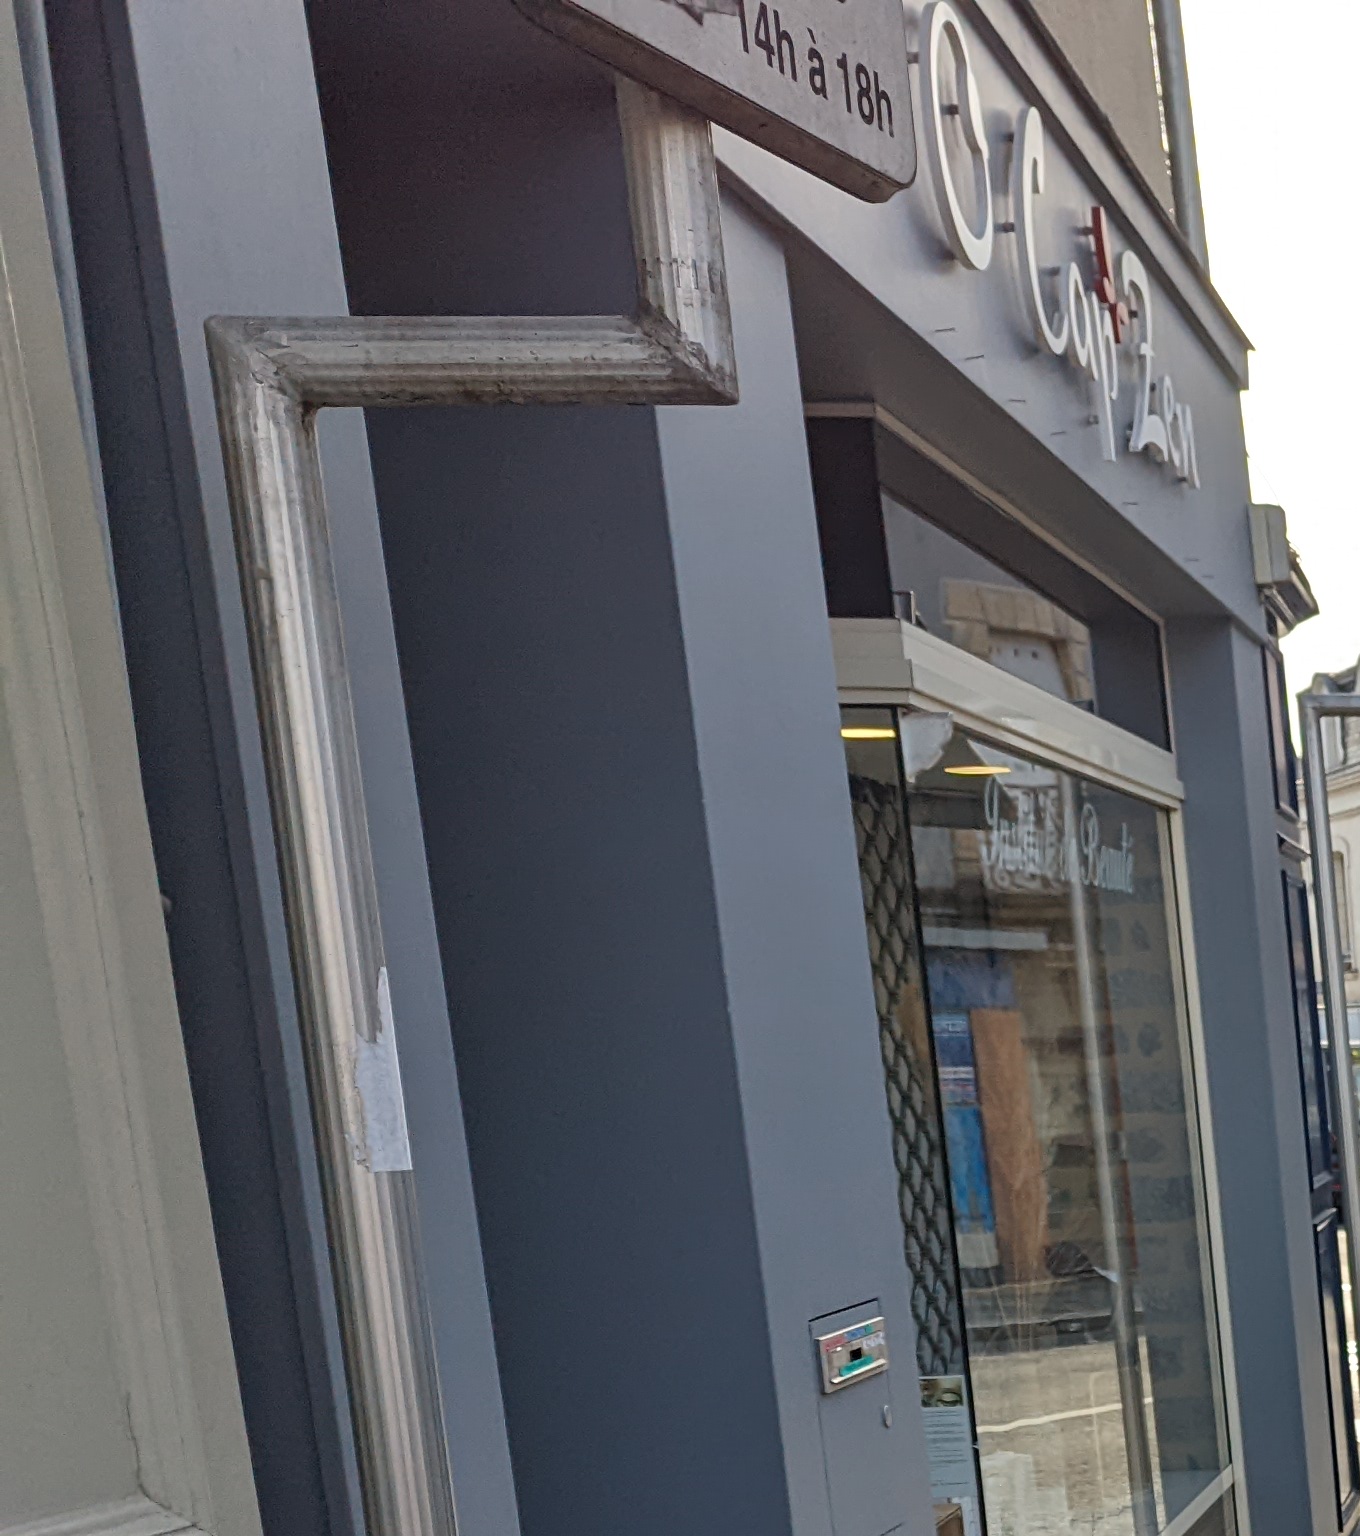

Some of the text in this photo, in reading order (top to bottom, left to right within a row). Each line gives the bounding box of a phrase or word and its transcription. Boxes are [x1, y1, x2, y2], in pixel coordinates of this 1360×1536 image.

[738, 0, 895, 138] 14h à 18h
